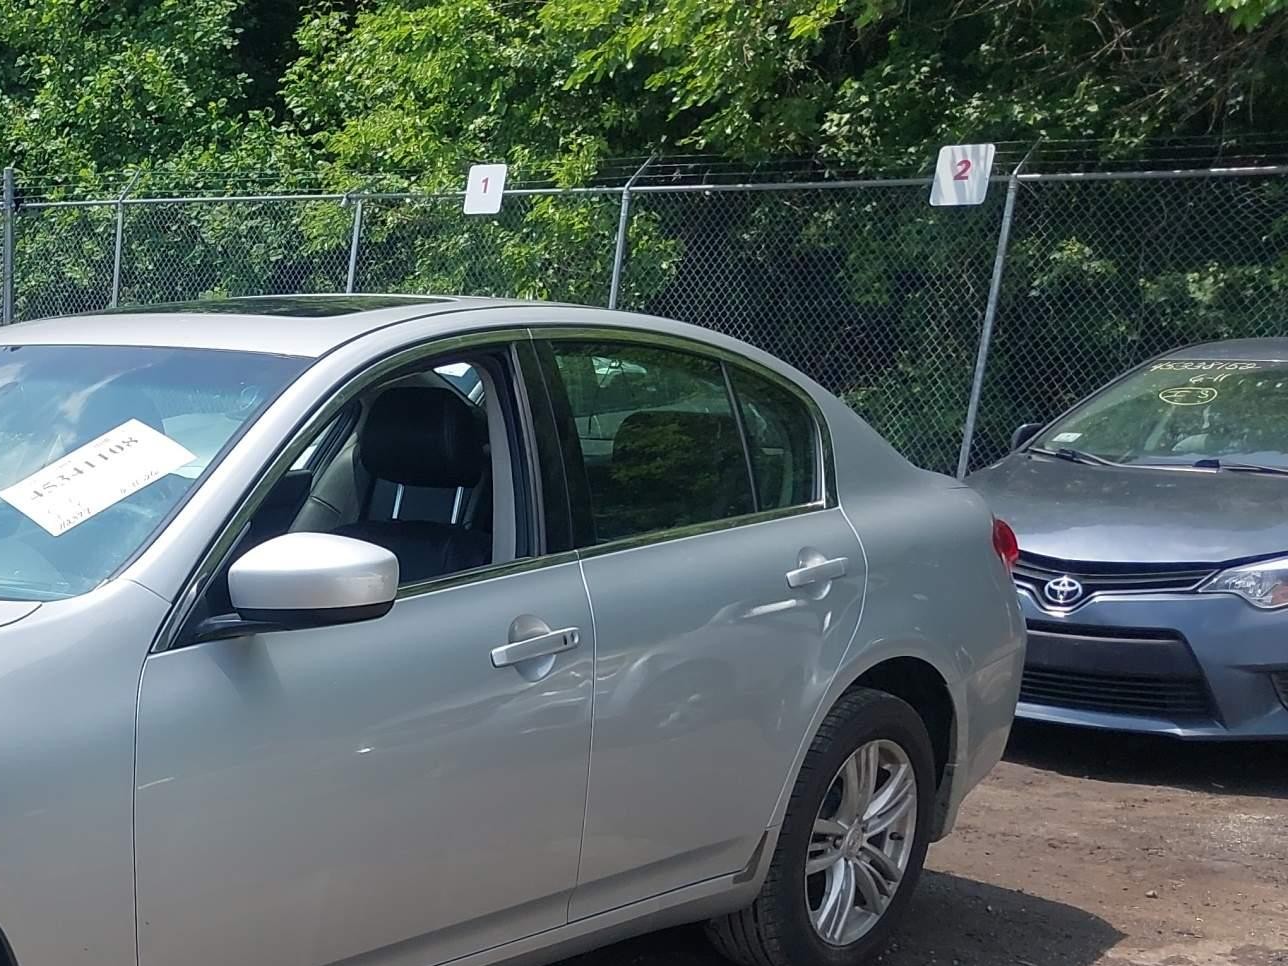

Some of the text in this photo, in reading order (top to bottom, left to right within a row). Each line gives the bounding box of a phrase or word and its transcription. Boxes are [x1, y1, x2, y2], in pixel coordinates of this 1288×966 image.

[953, 159, 972, 181] 2
[481, 177, 489, 194] 1
[31, 436, 139, 500] 45341108
